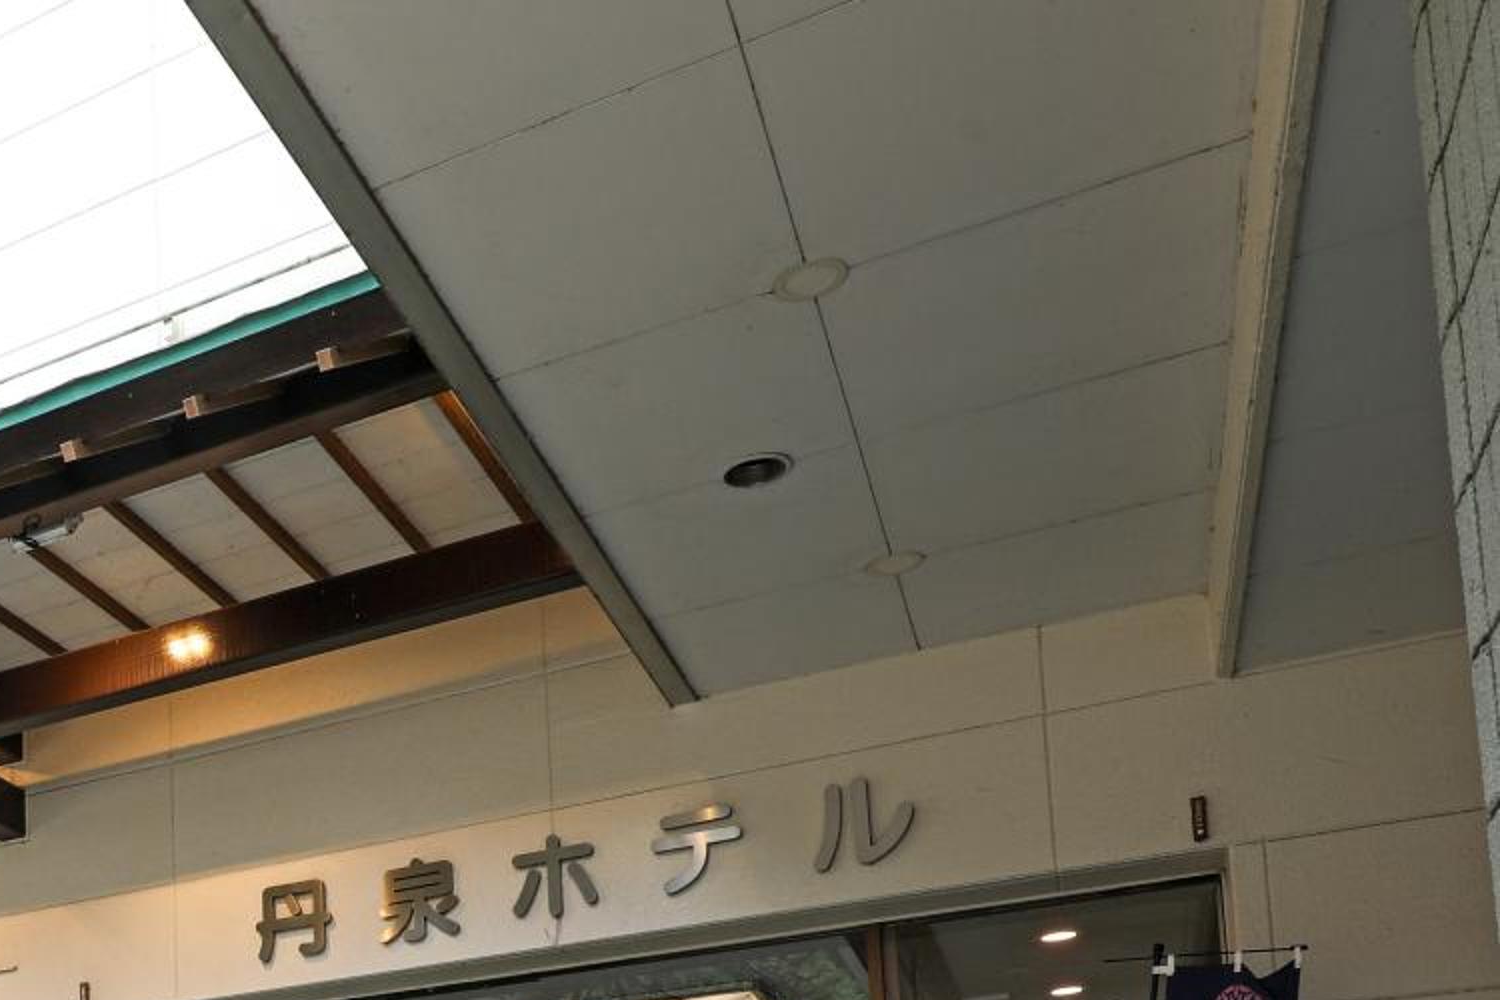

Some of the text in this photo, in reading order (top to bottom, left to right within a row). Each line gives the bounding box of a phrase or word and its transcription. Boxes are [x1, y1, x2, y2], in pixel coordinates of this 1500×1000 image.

[256, 777, 914, 963] 丹泉ホテル
